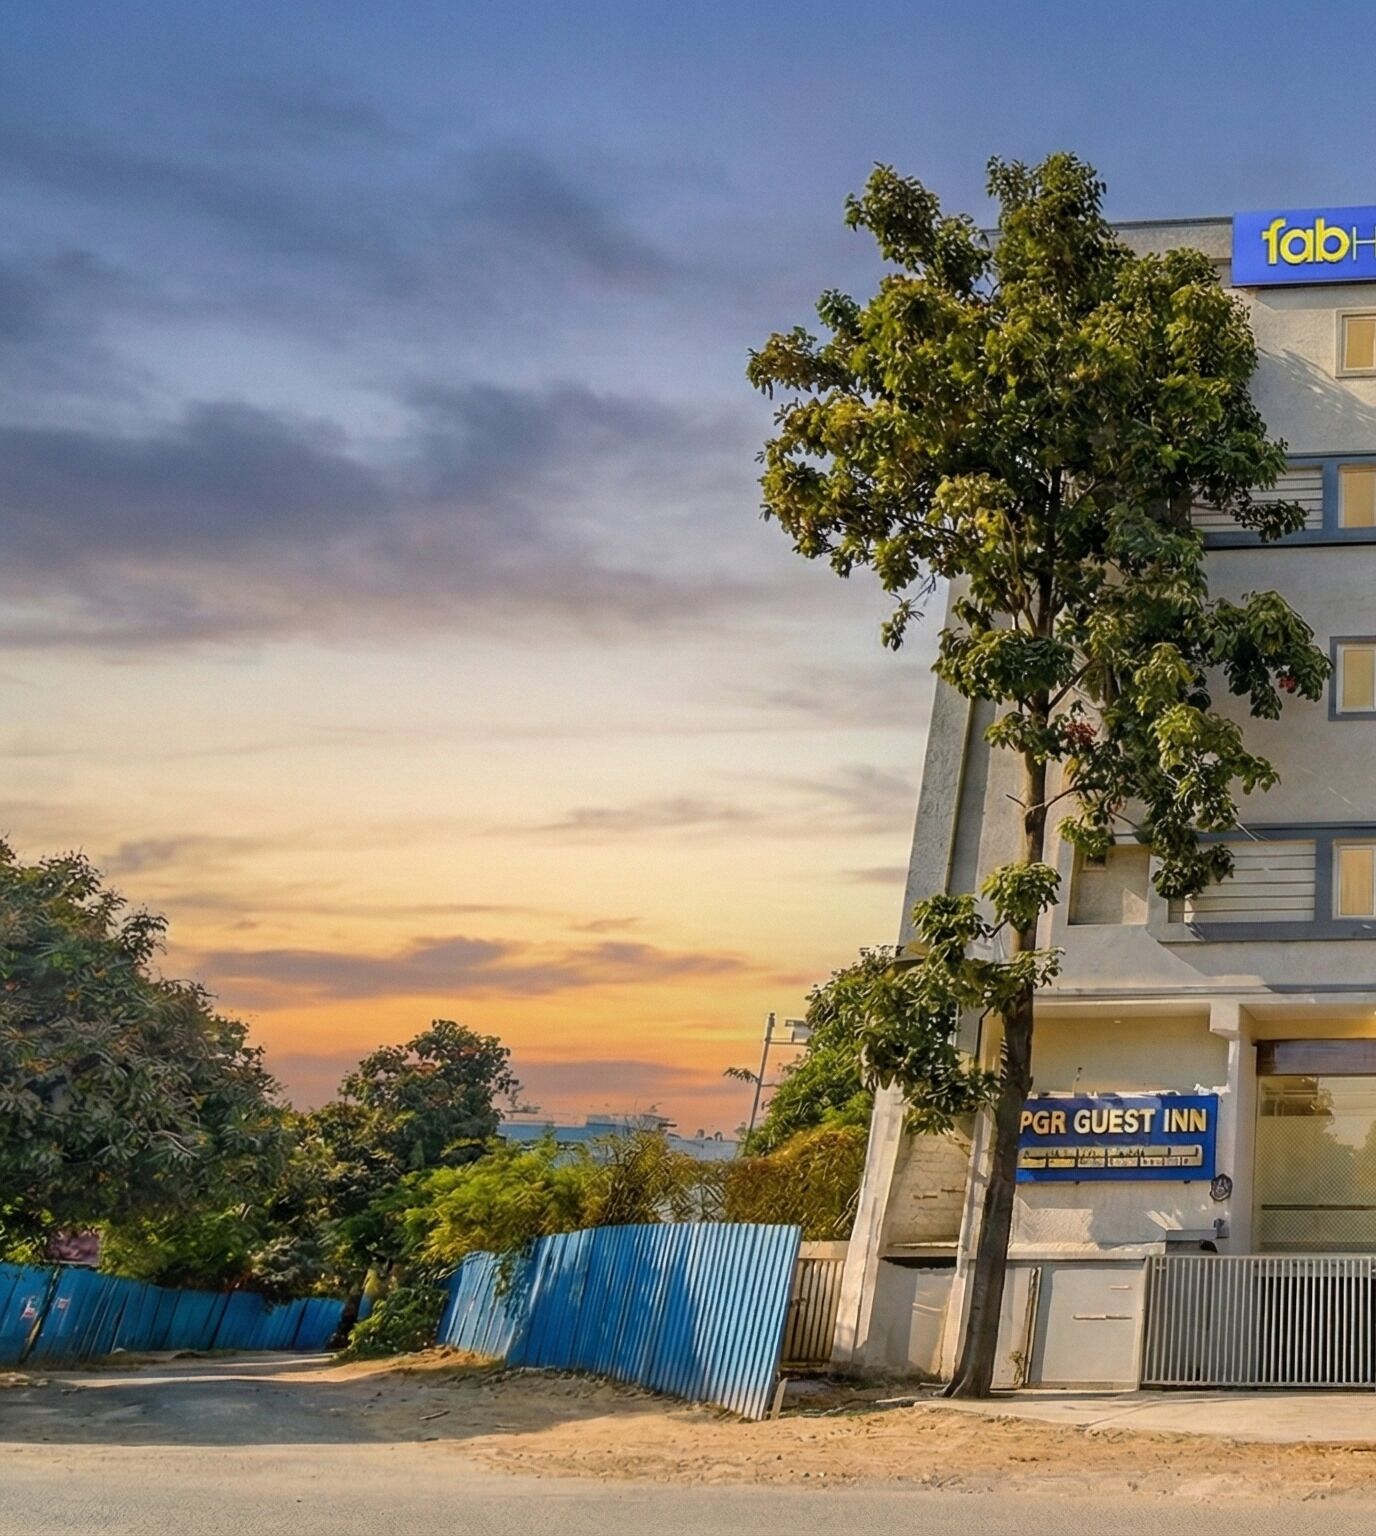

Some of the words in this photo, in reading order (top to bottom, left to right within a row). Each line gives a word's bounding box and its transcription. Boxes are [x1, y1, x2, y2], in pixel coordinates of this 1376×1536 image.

[1019, 1109, 1067, 1135] PGR
[1073, 1108, 1156, 1134] GUEST
[1163, 1108, 1207, 1133] INN
